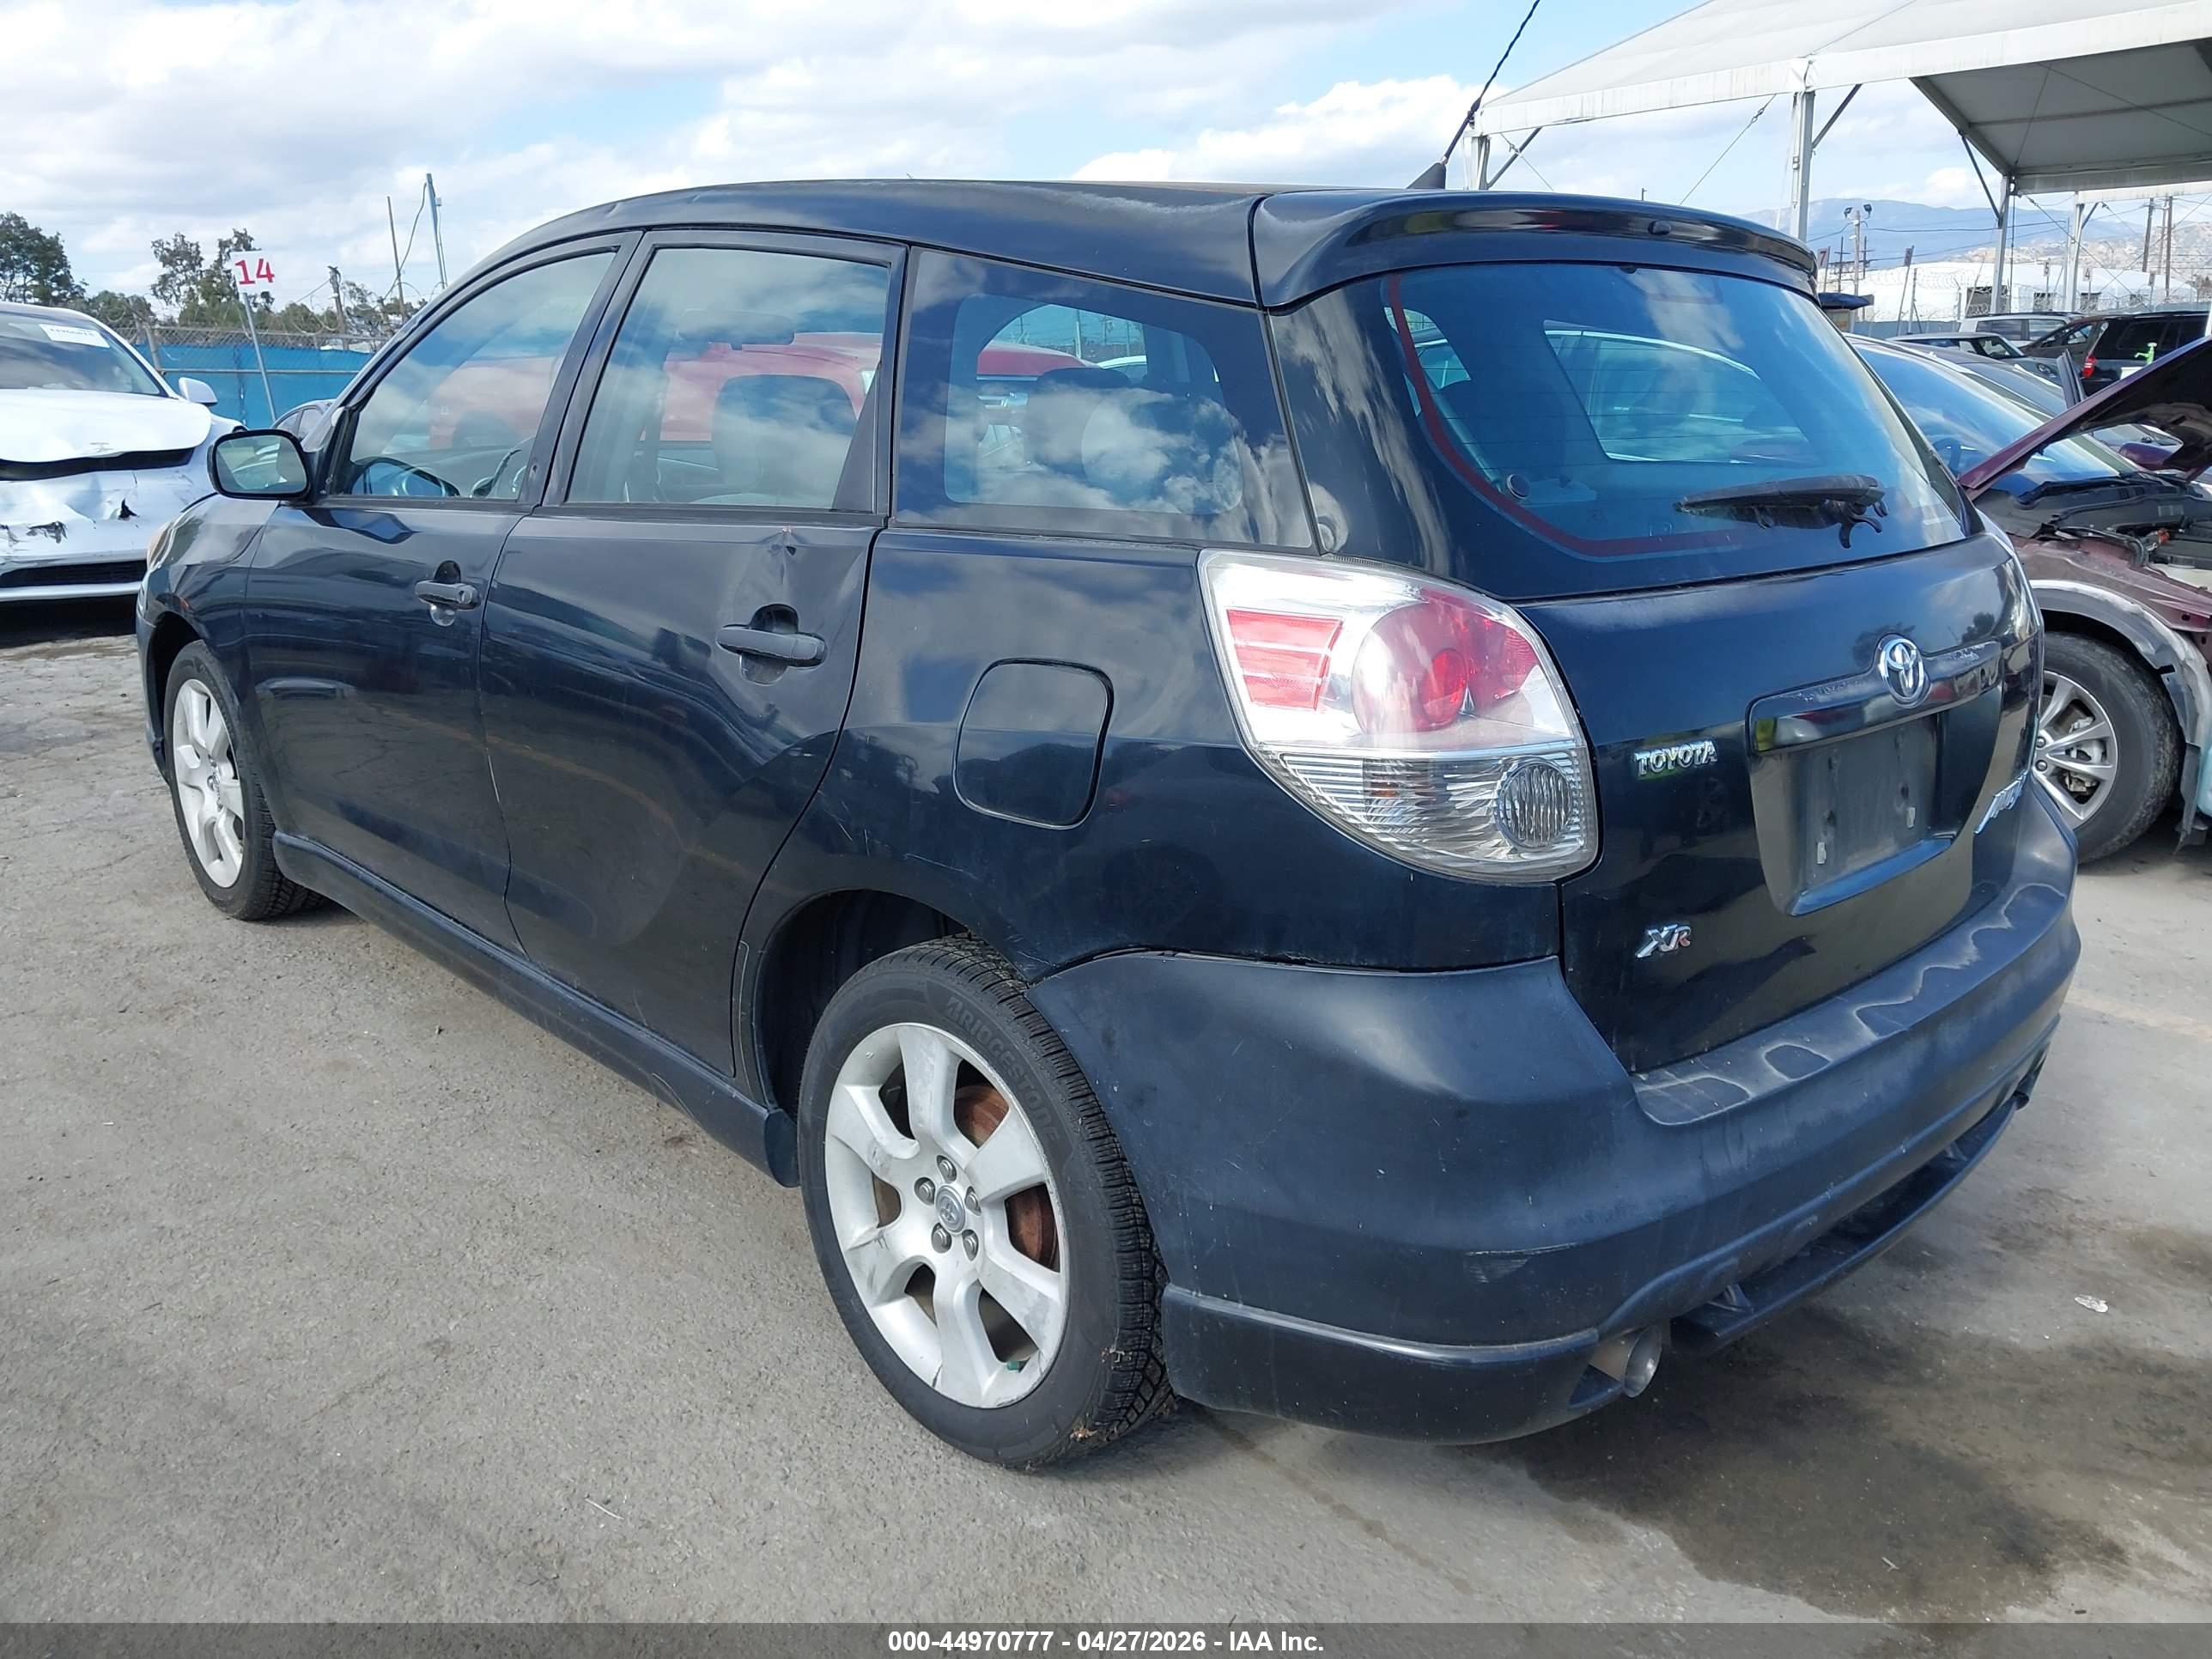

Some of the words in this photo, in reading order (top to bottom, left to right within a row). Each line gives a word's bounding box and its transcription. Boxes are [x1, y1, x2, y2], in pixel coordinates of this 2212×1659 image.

[235, 258, 275, 284] 14
[1820, 251, 1827, 267] 7
[2084, 268, 2091, 280] 4
[1634, 740, 1717, 776] TOYOTA
[1635, 924, 1692, 958] XR
